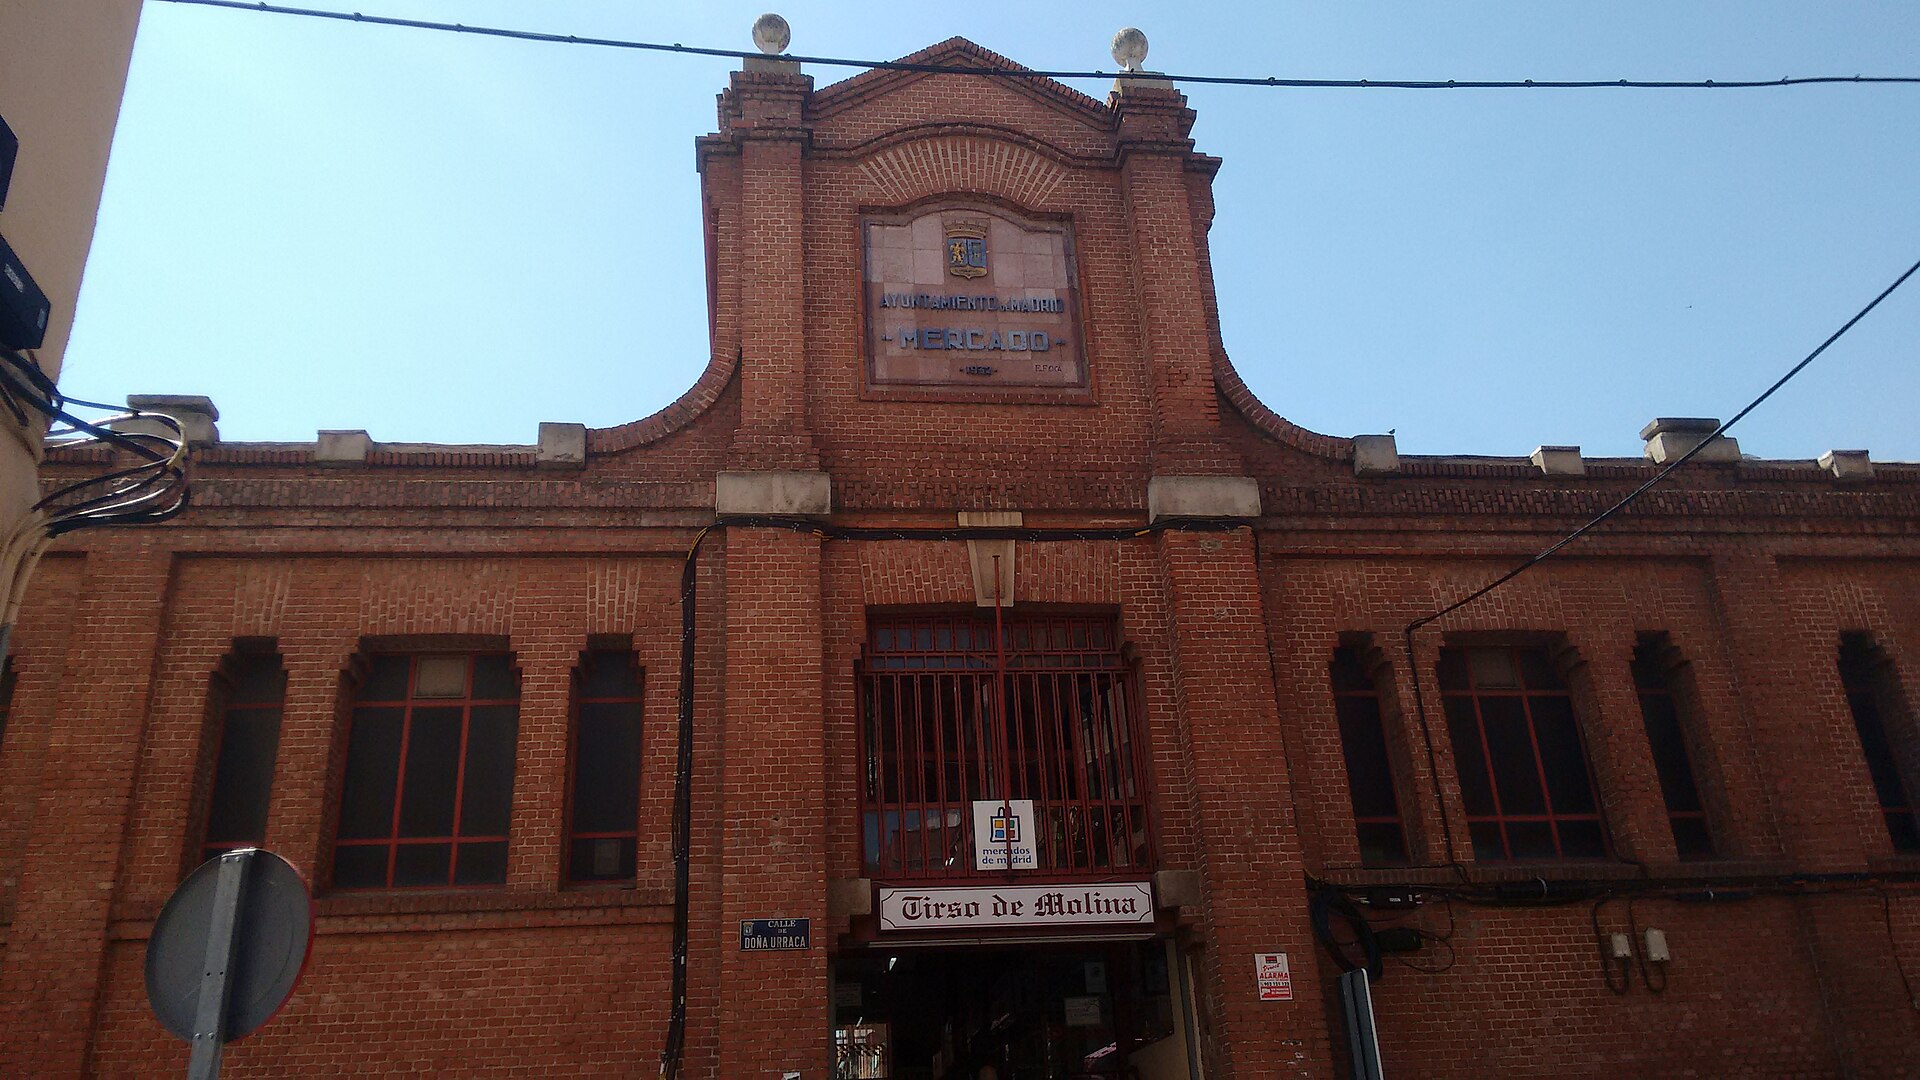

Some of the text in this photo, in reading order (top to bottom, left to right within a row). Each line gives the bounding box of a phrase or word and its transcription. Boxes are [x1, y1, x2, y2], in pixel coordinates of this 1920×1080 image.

[879, 294, 998, 311] AYUNTAMIENTO
[1011, 297, 1064, 314] MADRID
[899, 328, 1049, 351] MERCADO
[982, 846, 1031, 855] mercdos
[982, 855, 1032, 864] de mdrid
[901, 891, 1138, 921] Tirso de Molina
[768, 920, 796, 928] CALLE
[744, 935, 806, 949] DOÑA URRACA
